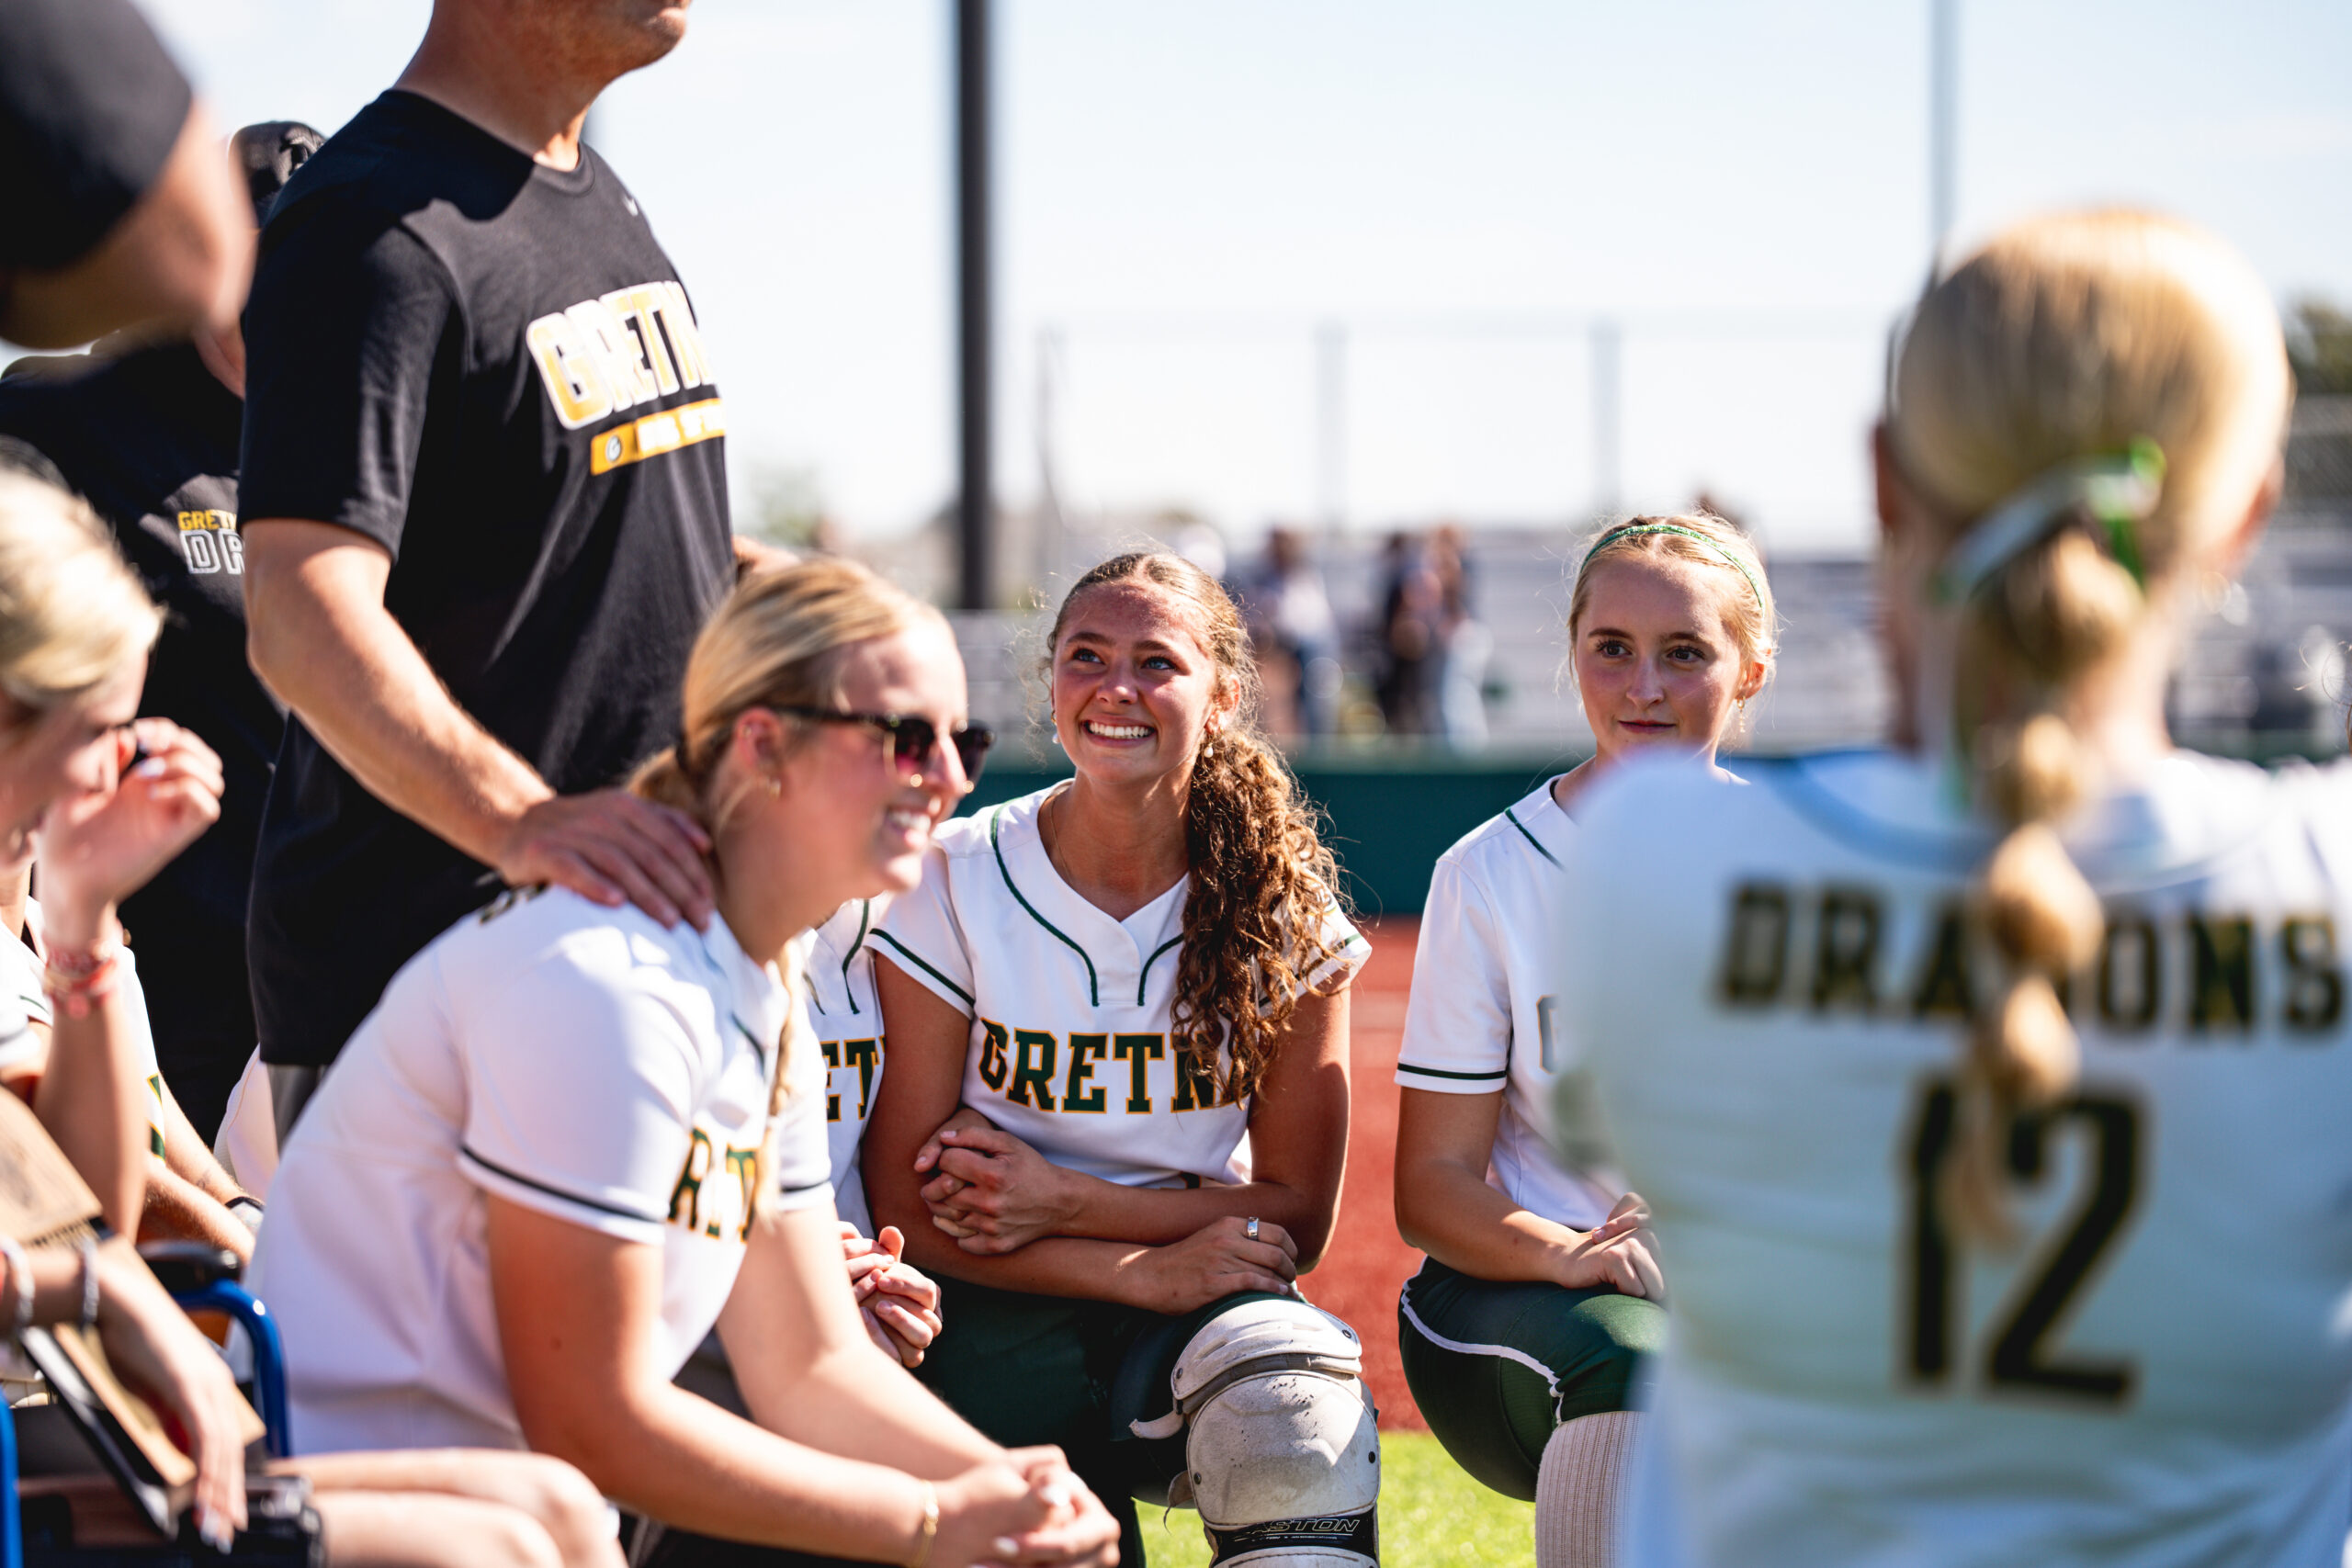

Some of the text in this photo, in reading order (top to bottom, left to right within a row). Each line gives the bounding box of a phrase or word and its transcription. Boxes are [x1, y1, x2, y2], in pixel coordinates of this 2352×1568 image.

[1720, 877, 2348, 1036] DRAONS
[1900, 1073, 2143, 1404] 12
[1248, 1517, 1360, 1536] STON
